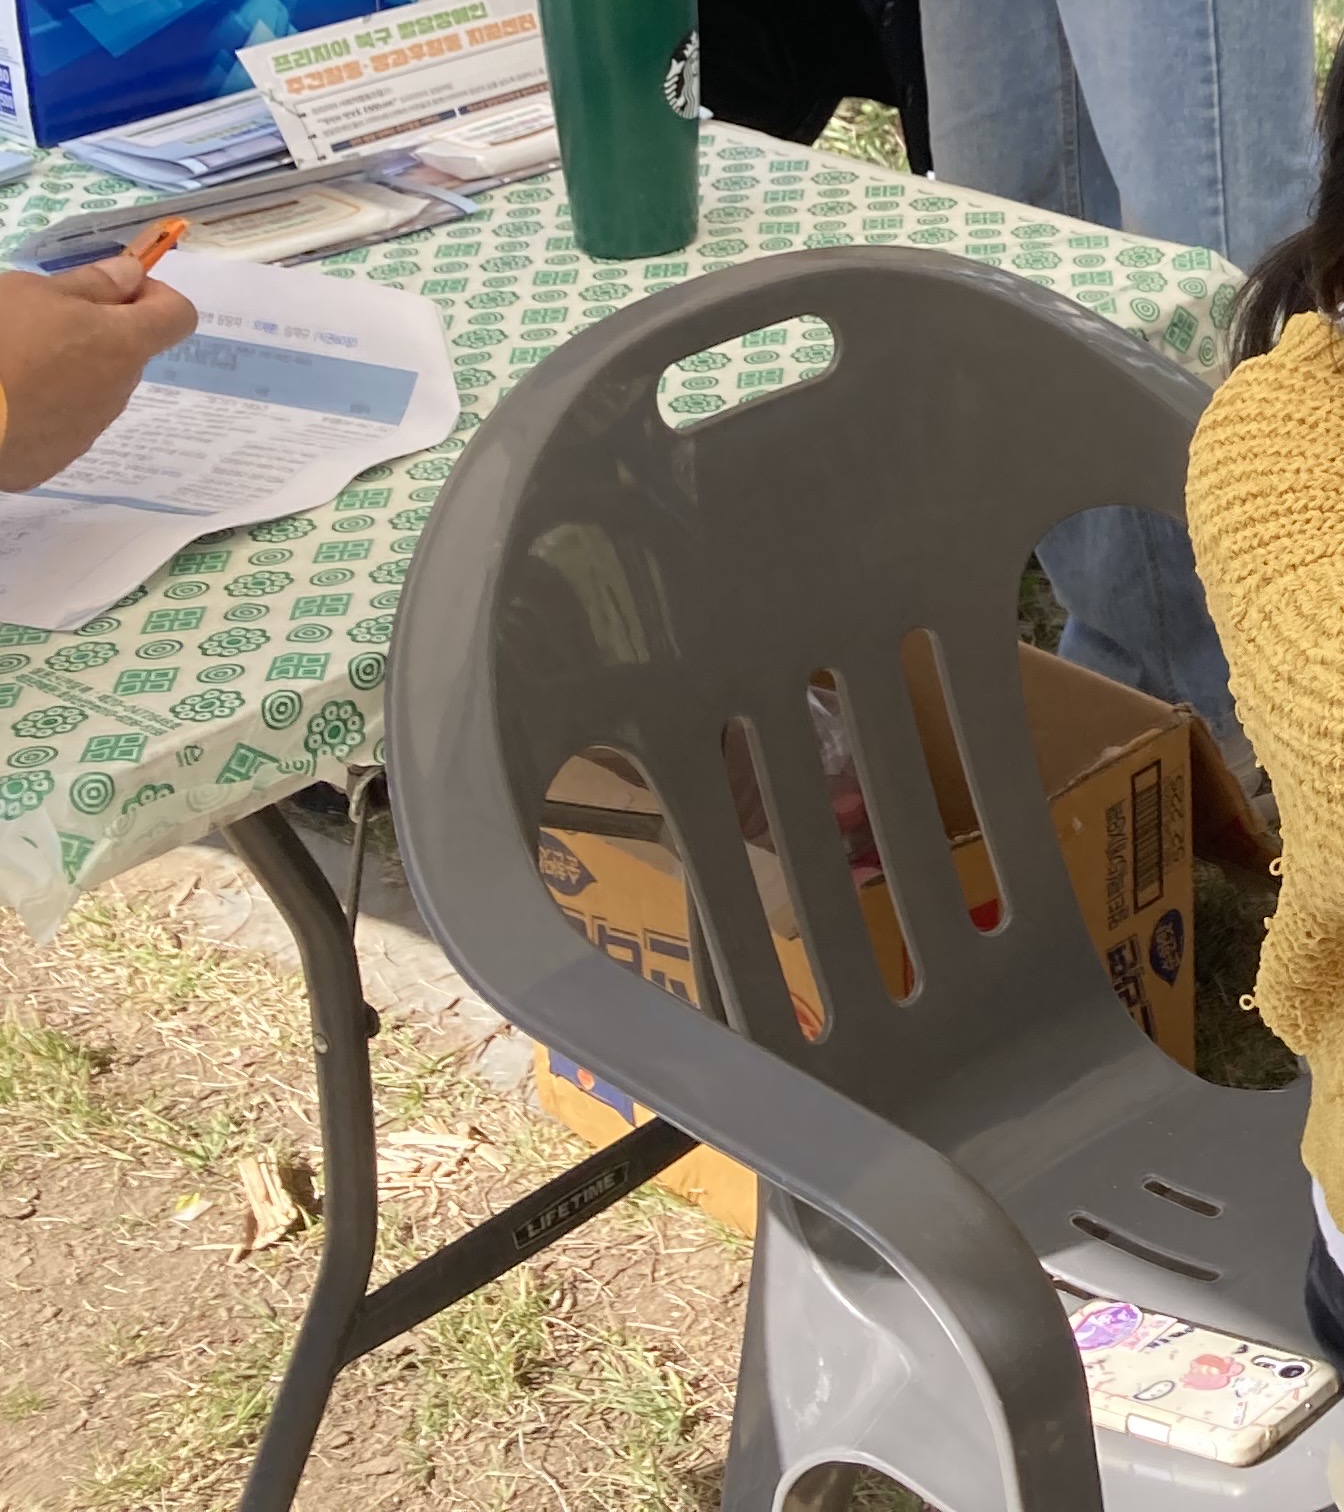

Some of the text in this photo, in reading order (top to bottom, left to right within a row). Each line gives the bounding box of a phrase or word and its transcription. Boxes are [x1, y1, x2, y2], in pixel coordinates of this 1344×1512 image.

[272, 1, 488, 74] 프리지아 북구 발달장애인
[526, 1173, 616, 1238] LIFETIME
